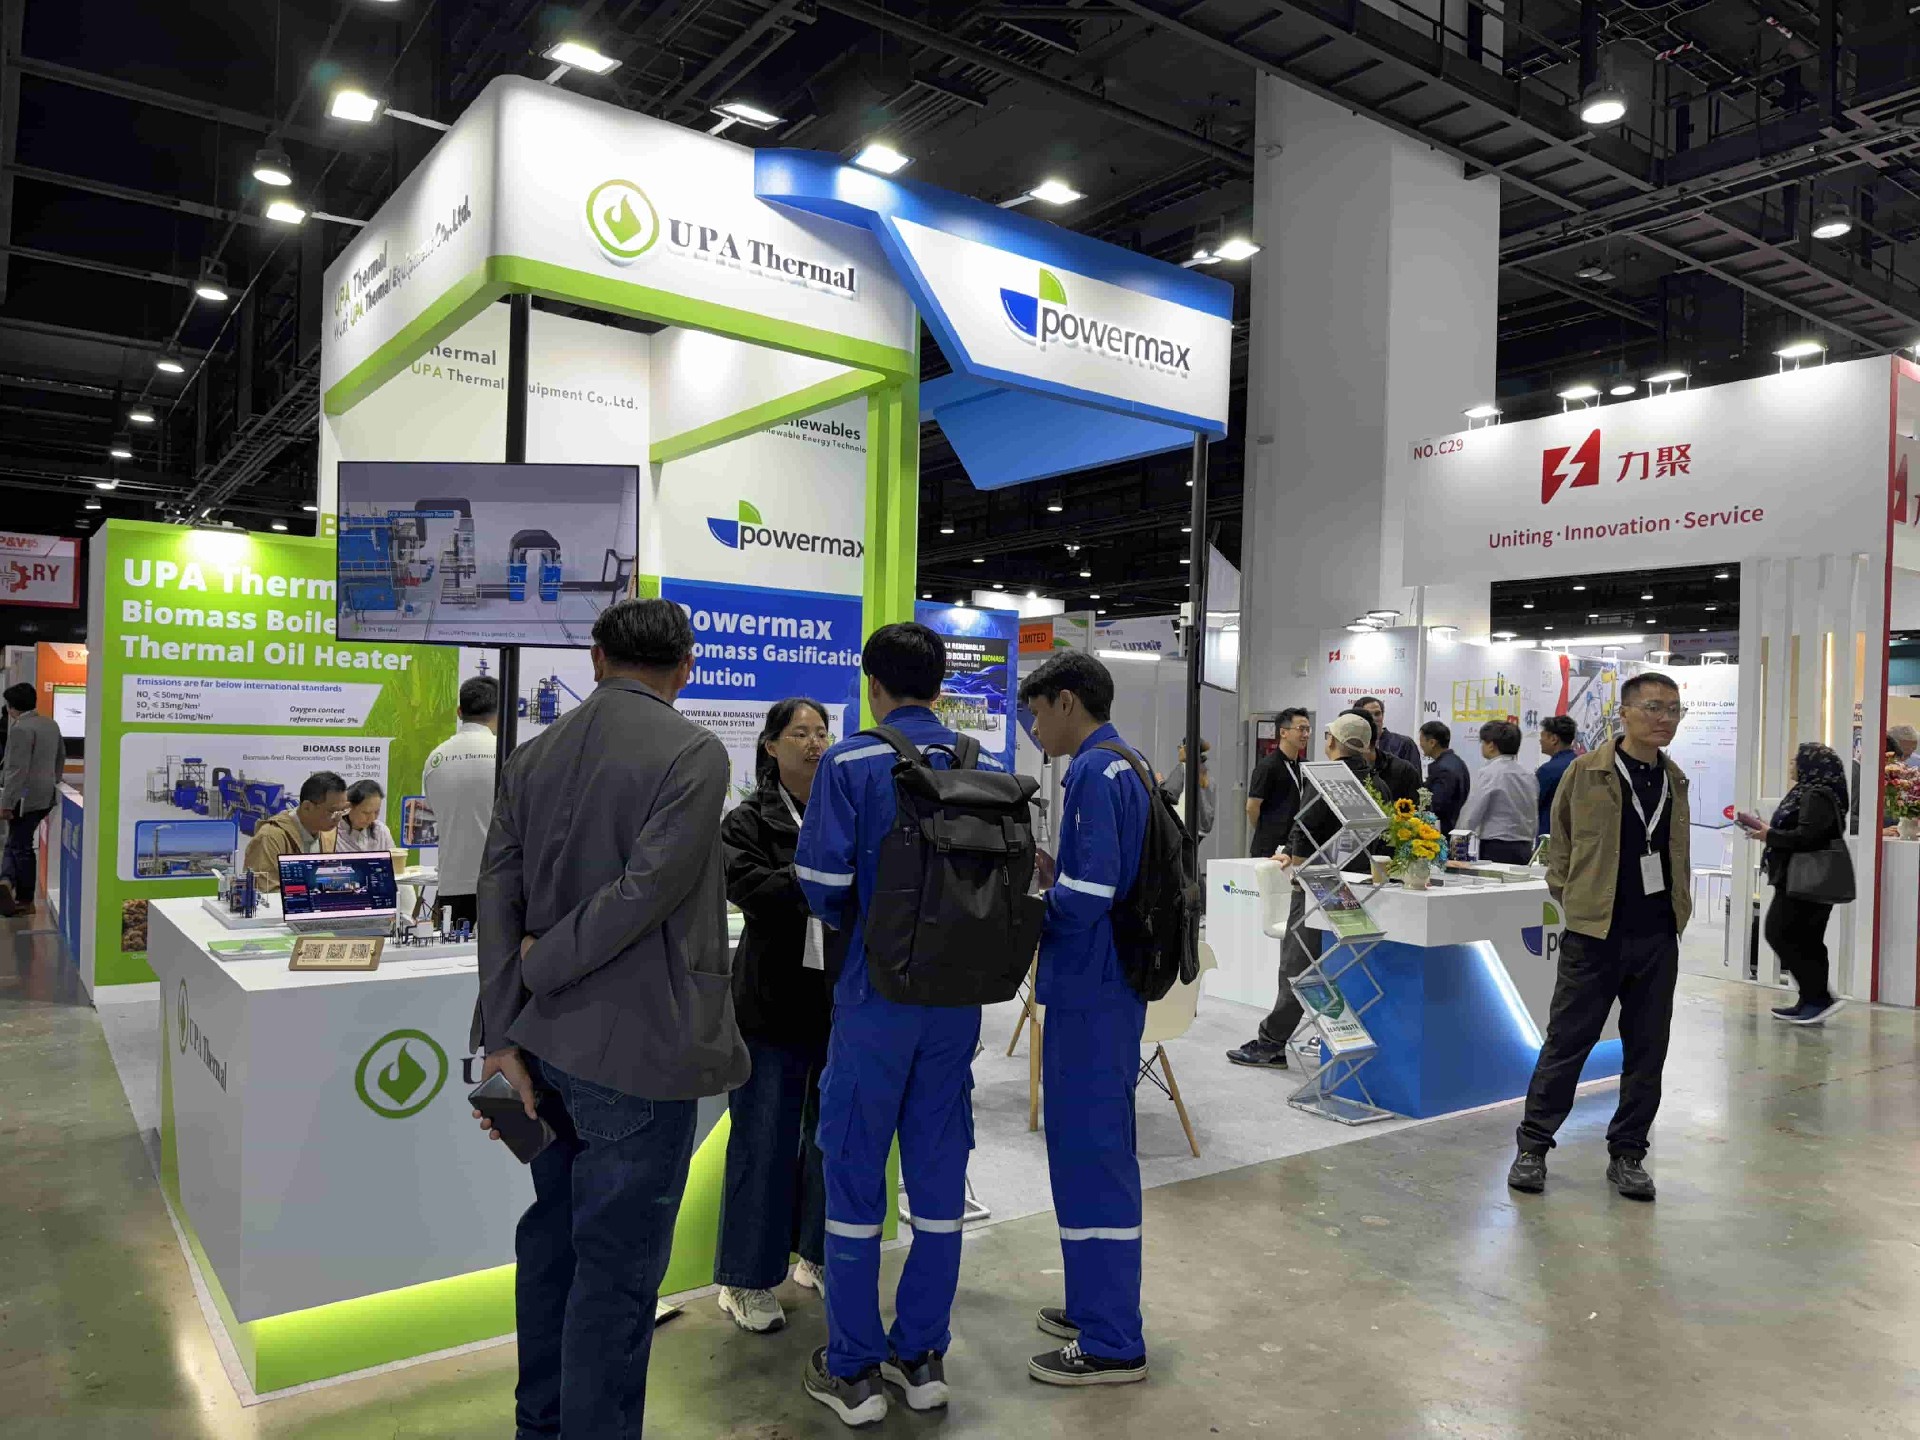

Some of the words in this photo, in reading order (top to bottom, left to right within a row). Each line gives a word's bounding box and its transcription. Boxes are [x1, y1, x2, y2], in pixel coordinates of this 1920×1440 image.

[668, 218, 741, 260] UPA
[747, 239, 856, 292] Thermal
[335, 281, 350, 316] UPA
[353, 240, 387, 297] Thermal
[351, 299, 364, 326] UPA
[365, 269, 392, 312] Thermal
[1041, 306, 1191, 371] powermax
[429, 346, 496, 366] hermal
[411, 362, 442, 379] UPA
[447, 368, 505, 390] Thermal
[528, 382, 584, 401] uipment
[802, 434, 831, 447] Energy
[833, 440, 867, 453] Technolo
[1414, 438, 1464, 460] NO.C29
[1616, 443, 1692, 483] 力聚
[124, 558, 207, 592] UPA
[217, 564, 336, 600] Therm
[122, 599, 257, 630] Biomass
[266, 609, 336, 635] Boile
[678, 603, 832, 641] owermax
[120, 634, 255, 663] Thermal
[263, 642, 305, 666] Oil
[315, 645, 412, 671] Heater
[1019, 633, 1046, 644] LIMITED
[691, 642, 757, 661] omass
[763, 645, 861, 667] Gasificatio
[137, 678, 181, 687] Emissions
[201, 680, 213, 688] far
[216, 680, 241, 689] below
[244, 681, 300, 691] international
[301, 684, 342, 692] standards
[687, 666, 755, 687] olution
[1348, 687, 1386, 695] Ultra-Low
[289, 706, 317, 714] Oxygen
[303, 745, 345, 753] BIOMASS
[1230, 887, 1260, 898] powerma
[203, 1035, 227, 1093] Thermal
